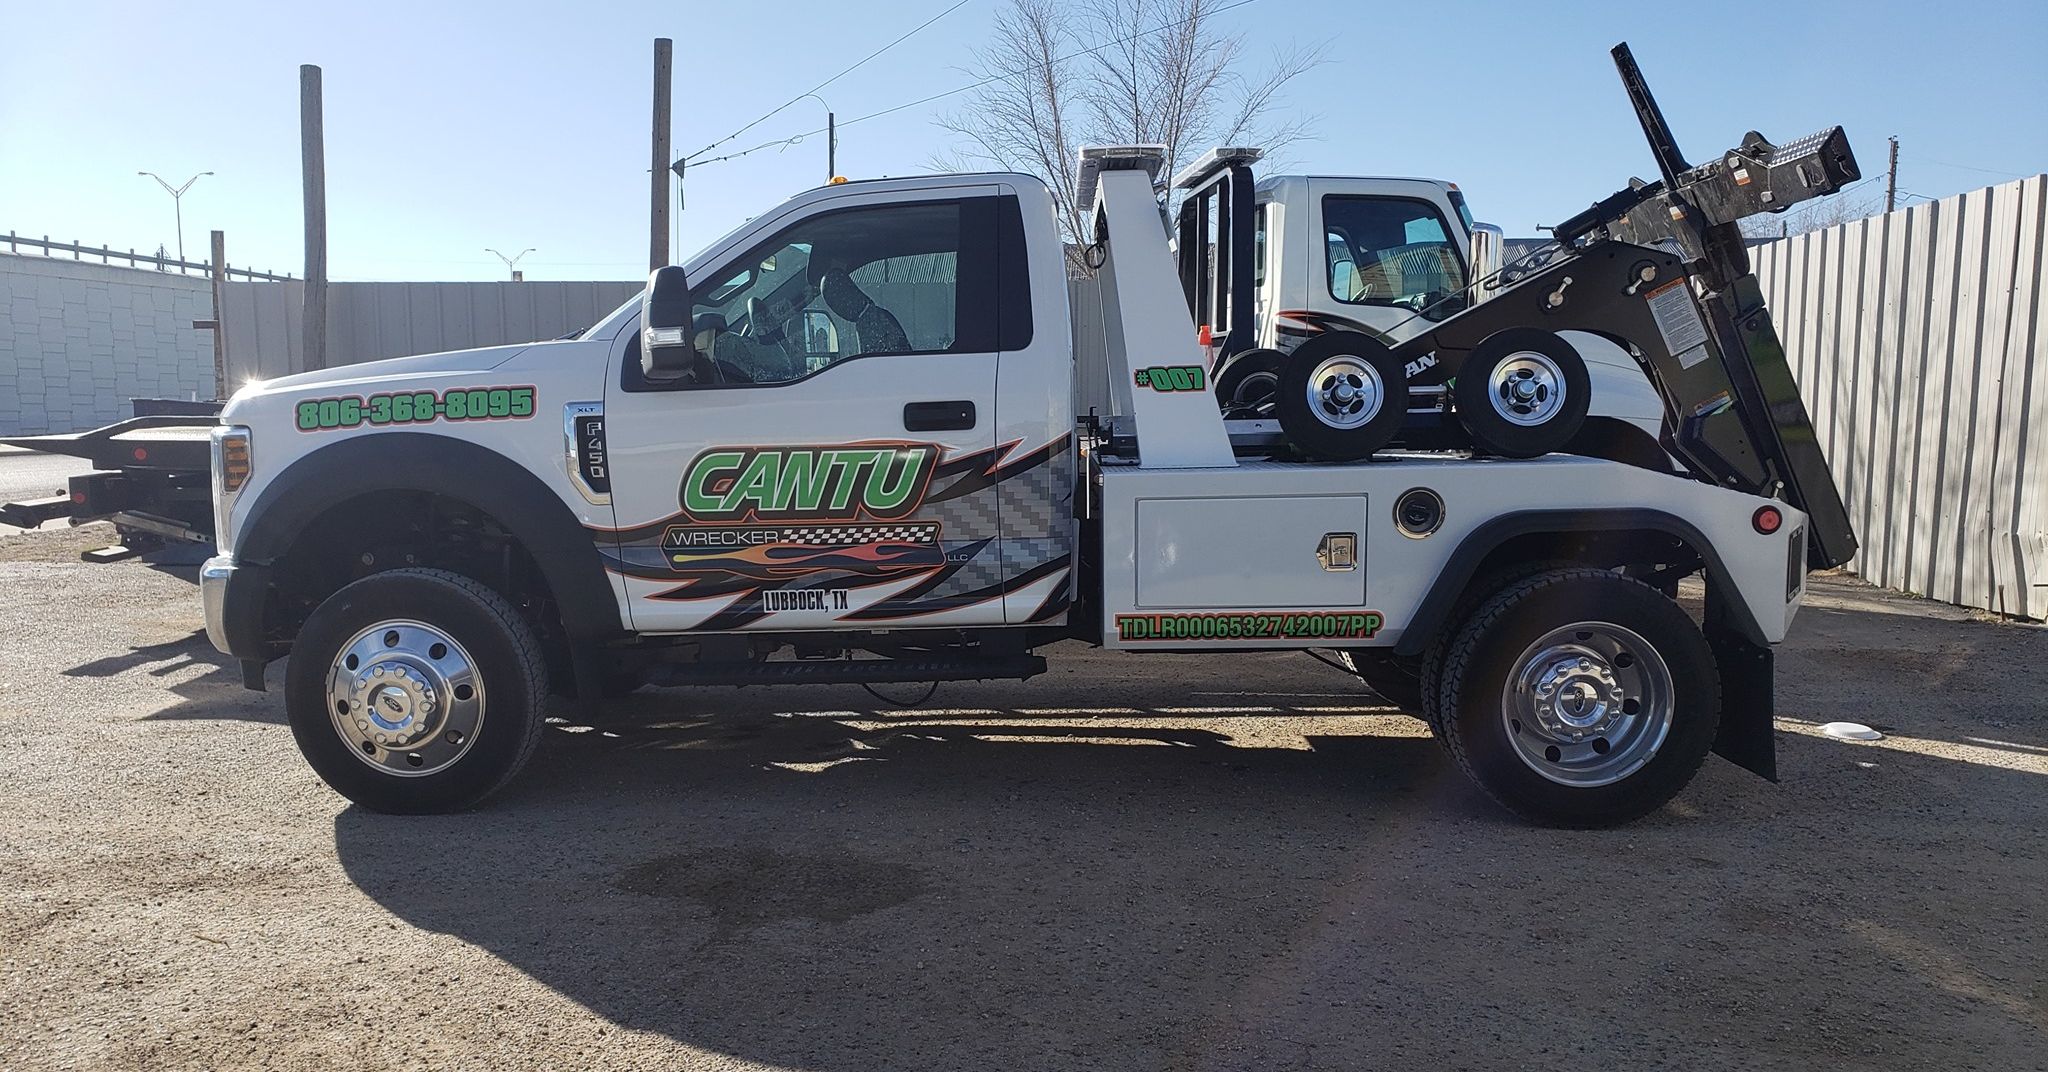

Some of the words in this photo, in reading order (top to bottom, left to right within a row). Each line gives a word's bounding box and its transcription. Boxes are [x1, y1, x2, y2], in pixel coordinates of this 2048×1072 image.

[1136, 367, 1204, 391] #007
[297, 387, 535, 430] 806-368-8095
[684, 449, 927, 512] CANTU
[671, 531, 779, 545] WRECKER
[947, 553, 969, 562] LLC
[763, 590, 829, 613] LUBBOCK,
[831, 589, 849, 610] TX
[1119, 614, 1381, 639] TDLR0006532742007PP
